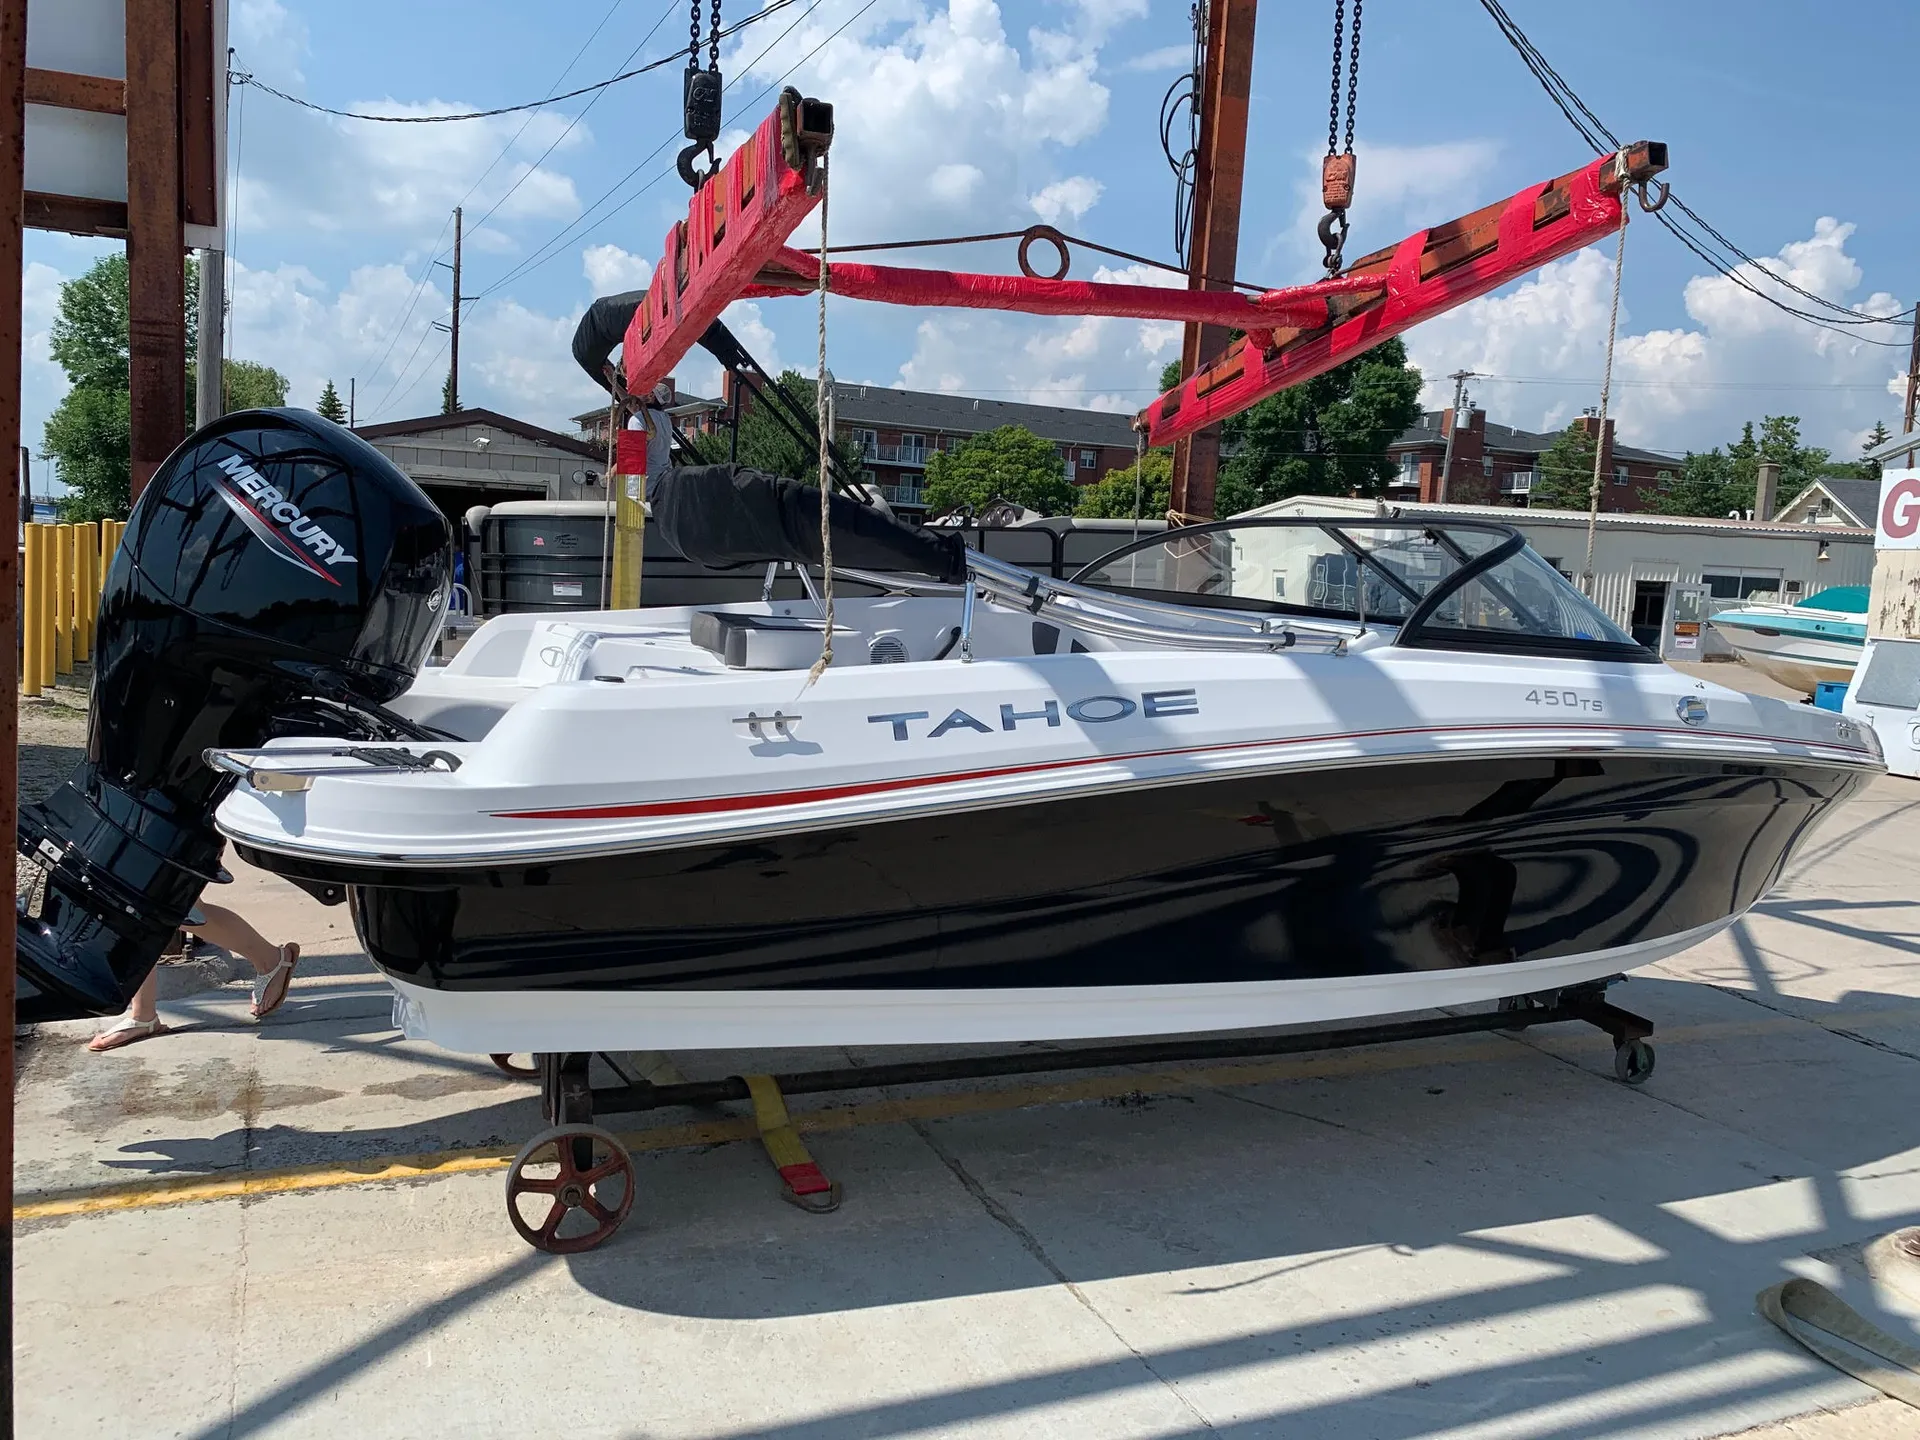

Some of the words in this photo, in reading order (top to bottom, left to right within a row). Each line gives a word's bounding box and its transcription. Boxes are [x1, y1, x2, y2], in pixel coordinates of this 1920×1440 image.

[217, 454, 358, 565] MERCURY
[1882, 478, 1920, 538] G
[867, 688, 1199, 741] TAHOE
